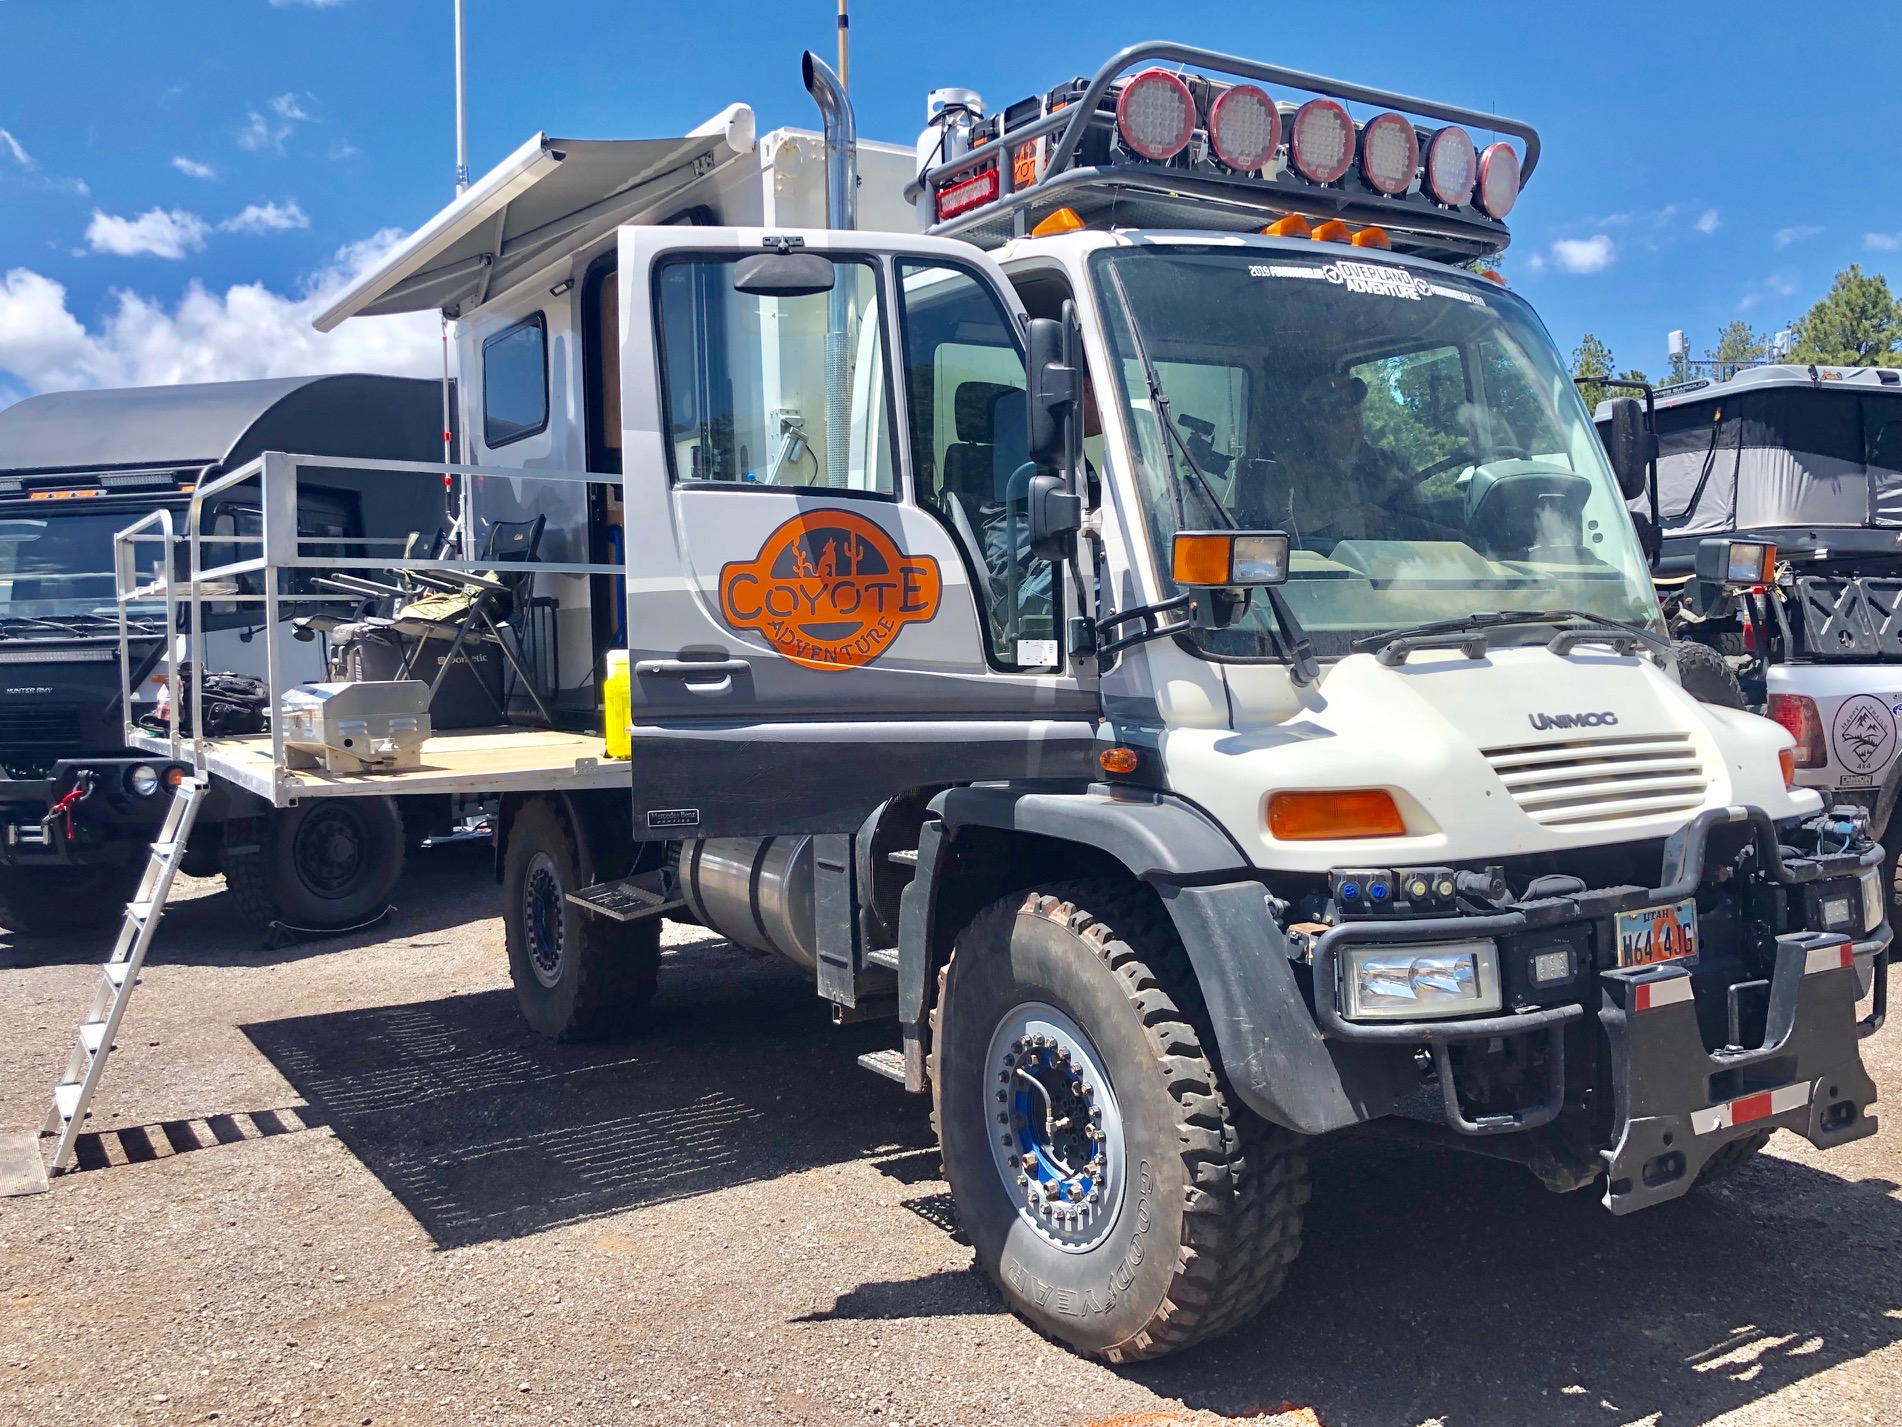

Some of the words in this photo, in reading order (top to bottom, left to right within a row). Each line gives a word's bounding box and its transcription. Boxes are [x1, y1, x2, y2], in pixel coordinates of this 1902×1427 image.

[1249, 265, 1270, 277] 2019
[1340, 263, 1412, 285] OVERLAND
[1346, 278, 1422, 301] ADVENTURE
[727, 566, 929, 621] COYOTE
[767, 616, 895, 664] ADVENTURE
[1528, 711, 1619, 731] UNIMOG
[1643, 909, 1669, 923] UTAH
